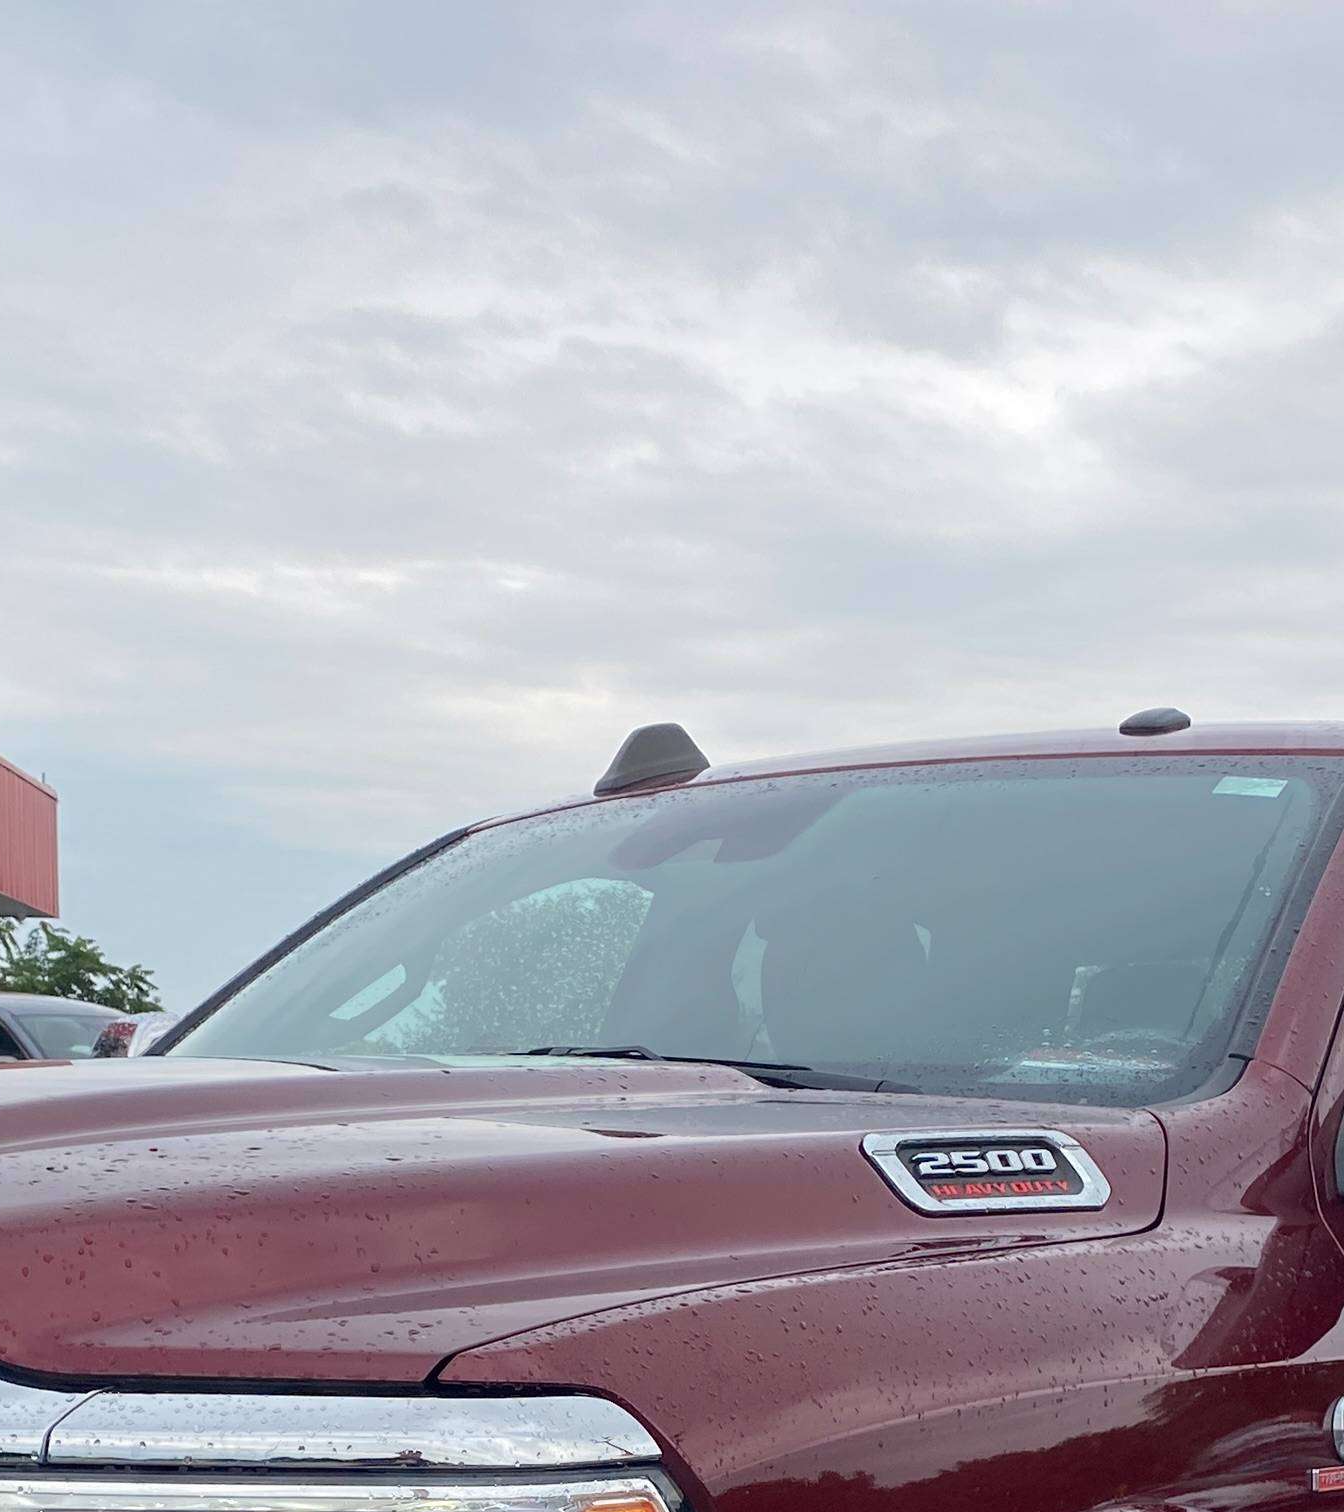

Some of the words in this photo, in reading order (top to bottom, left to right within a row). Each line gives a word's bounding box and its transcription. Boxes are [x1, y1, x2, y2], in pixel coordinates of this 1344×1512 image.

[912, 1149, 1058, 1178] 2500
[930, 1182, 1007, 1196] HEAVY
[1012, 1180, 1071, 1194] DUTY
